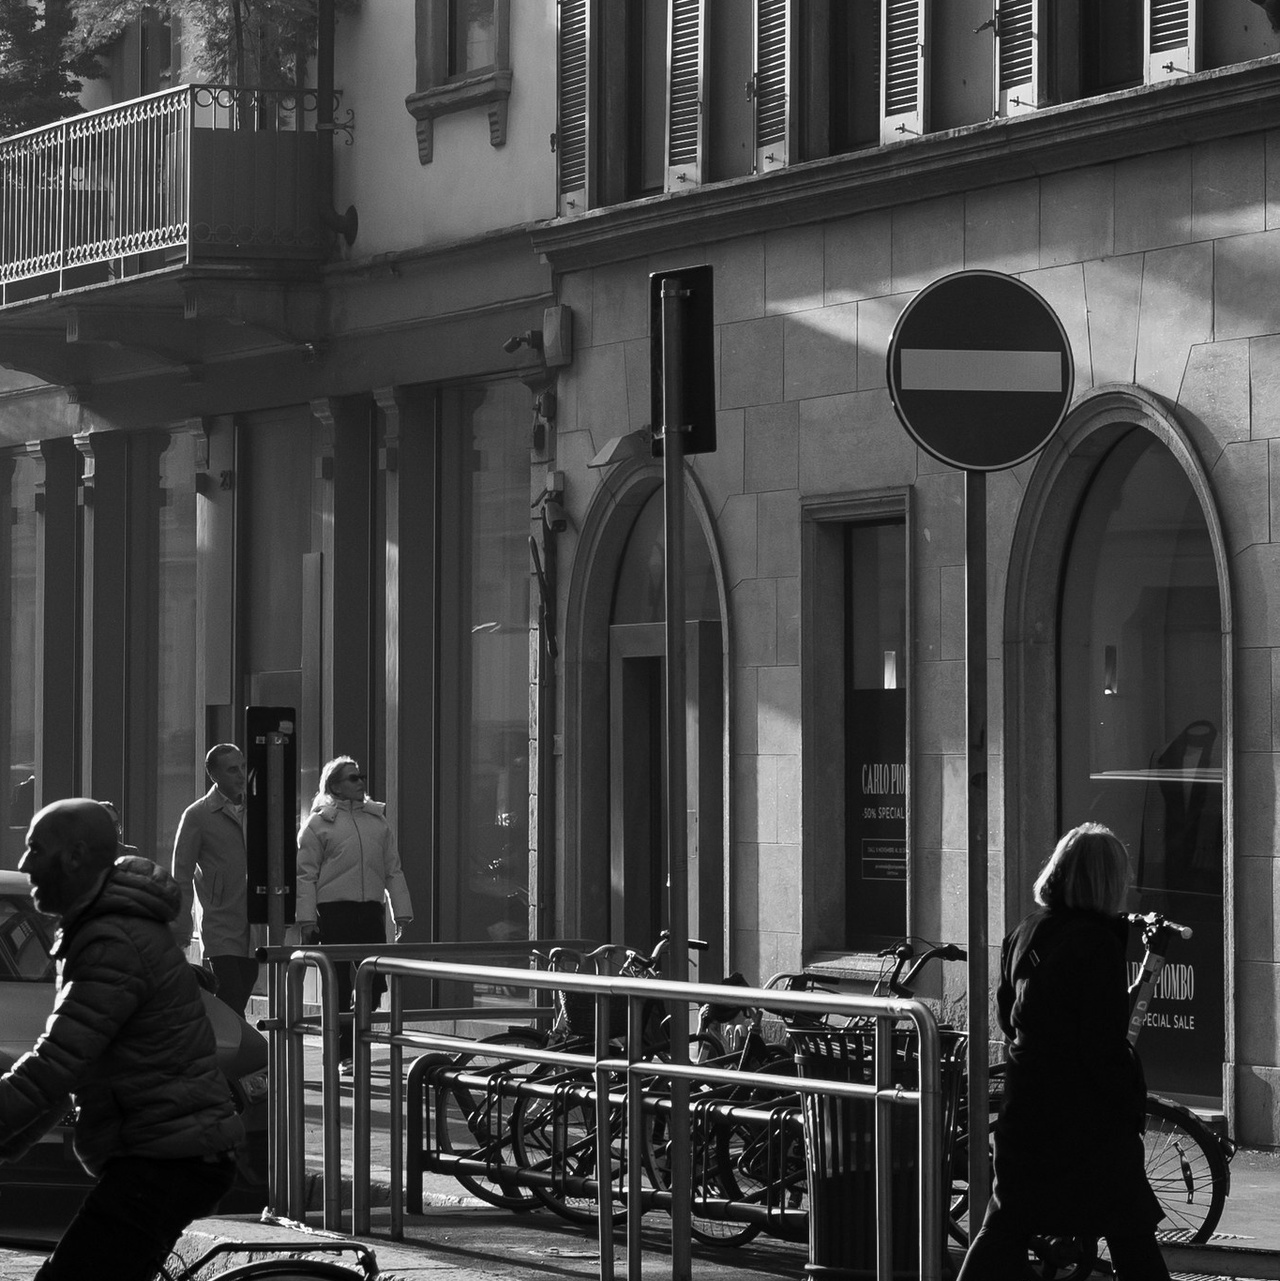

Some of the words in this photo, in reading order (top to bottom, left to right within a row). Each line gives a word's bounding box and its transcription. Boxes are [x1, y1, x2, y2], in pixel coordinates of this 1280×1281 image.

[862, 763, 890, 795] CARLO
[891, 763, 906, 795] PIO
[878, 806, 905, 819] SPECIAL
[1128, 1001, 1148, 1036] IRD
[1142, 1012, 1171, 1028] PECIAL
[1173, 1015, 1195, 1030] SALE
